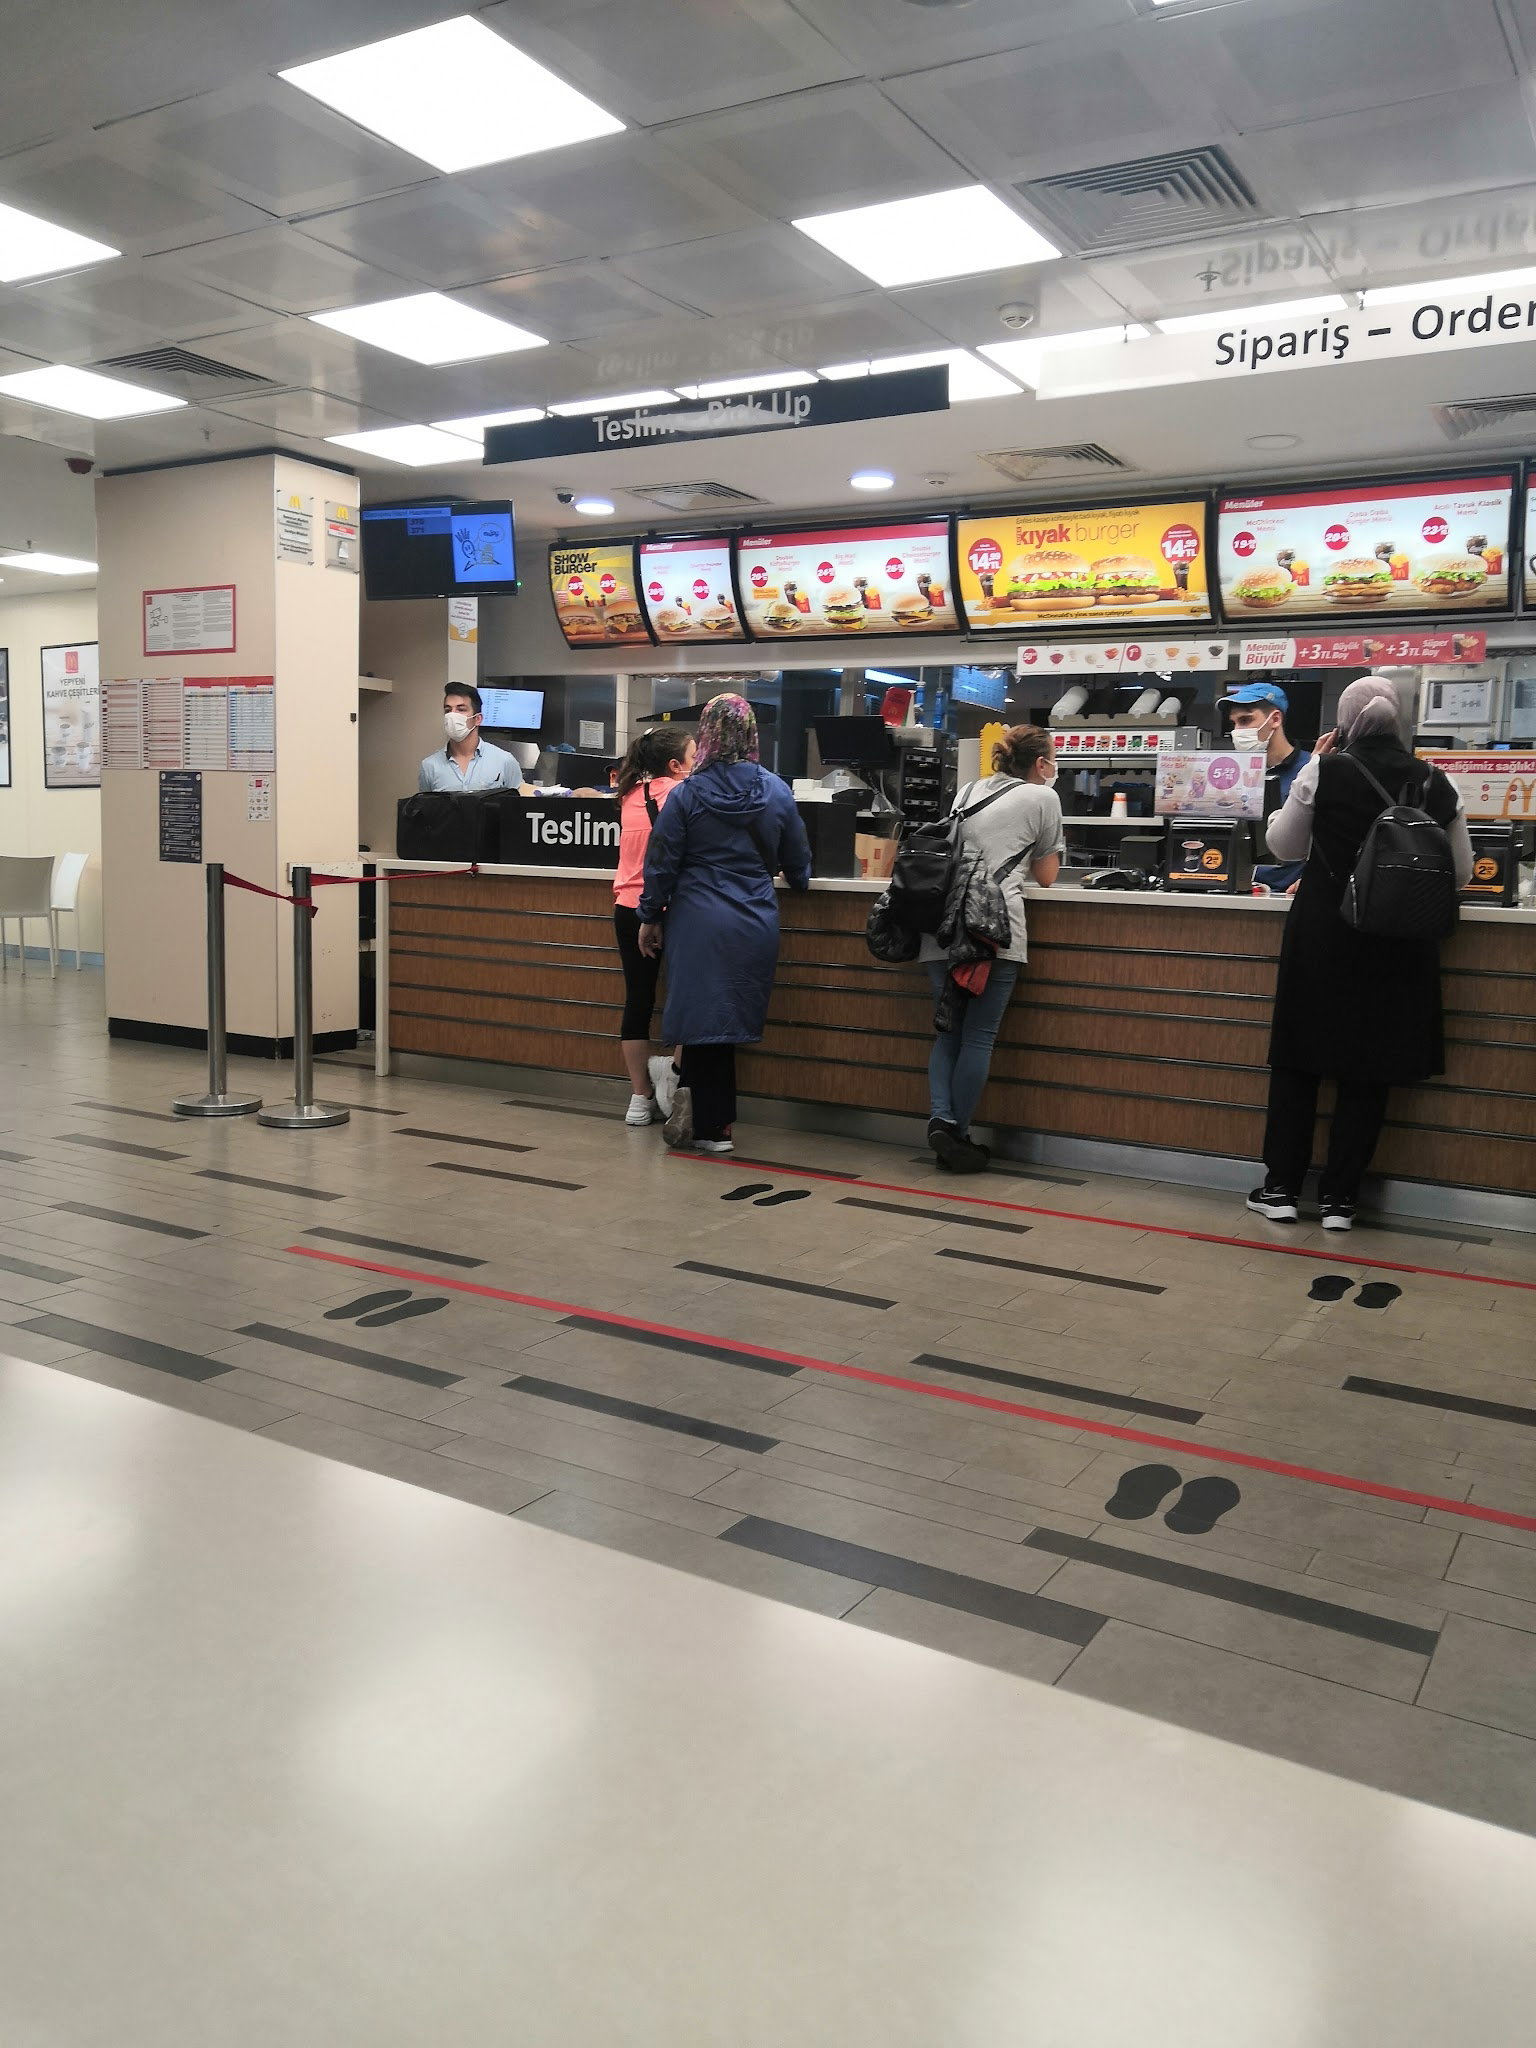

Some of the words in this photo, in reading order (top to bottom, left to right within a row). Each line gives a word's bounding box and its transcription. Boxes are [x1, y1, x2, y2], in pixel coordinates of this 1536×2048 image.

[1215, 317, 1350, 370] Sipariş
[592, 408, 676, 443] Teslim
[771, 390, 812, 425] Up
[1223, 499, 1265, 510] Menüler
[1020, 523, 1071, 549] kıyak
[1075, 521, 1140, 545] burger
[742, 538, 773, 547] Menüler
[1161, 540, 1186, 559] 14
[554, 552, 590, 565] SHOW
[968, 553, 990, 571] 14
[1245, 642, 1288, 652] Menünü
[1422, 638, 1450, 649] Süper
[1245, 652, 1286, 667] Büyüt
[1332, 651, 1350, 661] Boy
[1421, 648, 1441, 658] Boy
[60, 674, 86, 687] YEPYENİ
[46, 690, 68, 699] KAHVE
[1495, 760, 1536, 774] sağlık!
[525, 811, 621, 847] Teslim
